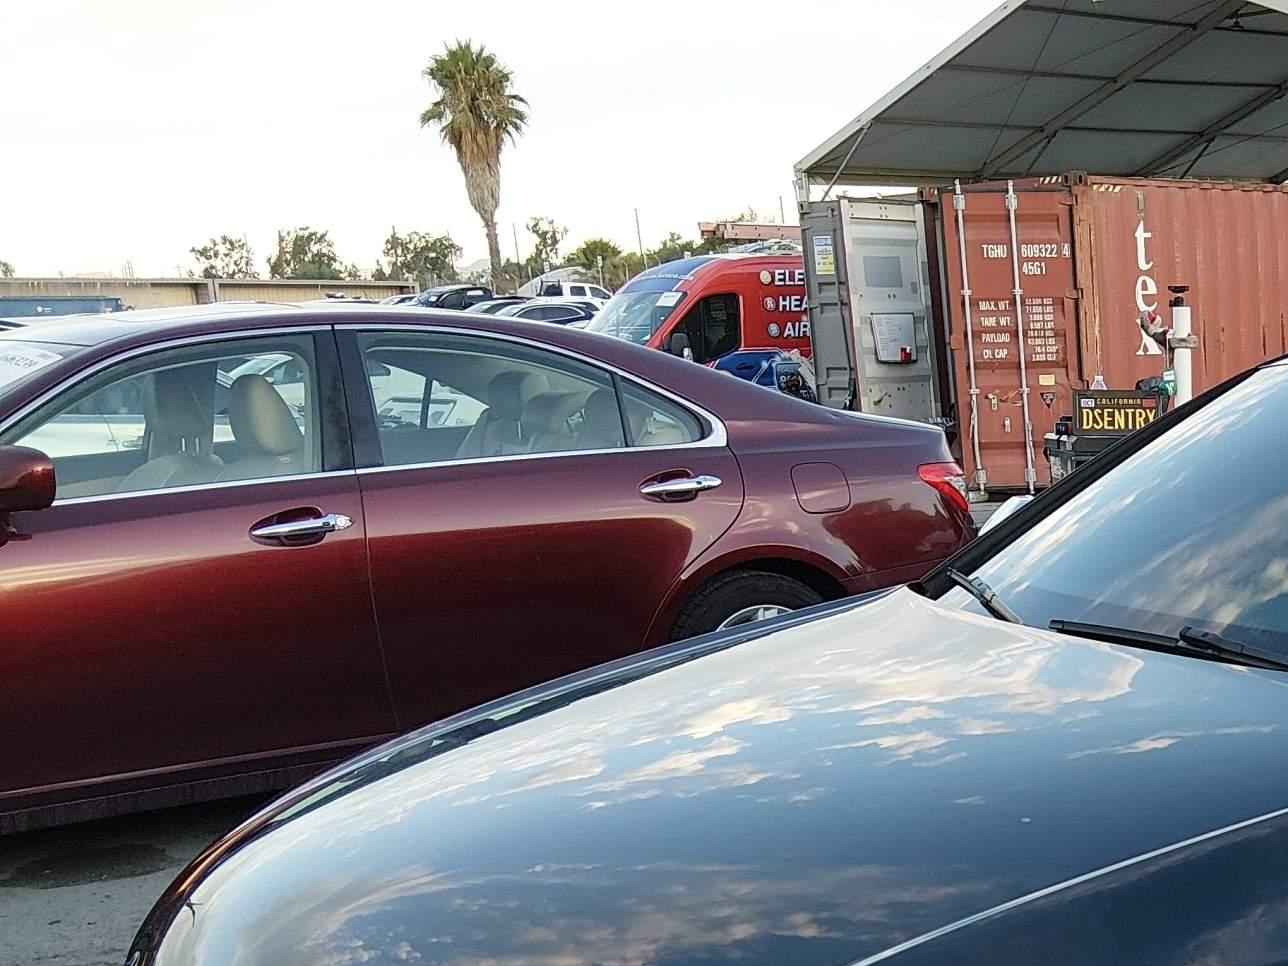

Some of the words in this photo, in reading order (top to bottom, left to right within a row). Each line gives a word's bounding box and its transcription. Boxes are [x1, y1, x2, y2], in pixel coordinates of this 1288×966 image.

[982, 245, 1007, 258] TGHU
[1021, 244, 1058, 257] 609322
[1062, 243, 1070, 257] 4
[1022, 261, 1046, 275] 45G1
[979, 300, 997, 311] MAX.
[998, 300, 1012, 311] WT.
[981, 316, 997, 327] TARE
[999, 316, 1013, 326] WT.
[783, 321, 810, 337] AIR
[981, 332, 1011, 343] PAYLOAD
[994, 348, 1009, 359] CAP.
[1082, 408, 1156, 430] DSENTRY
